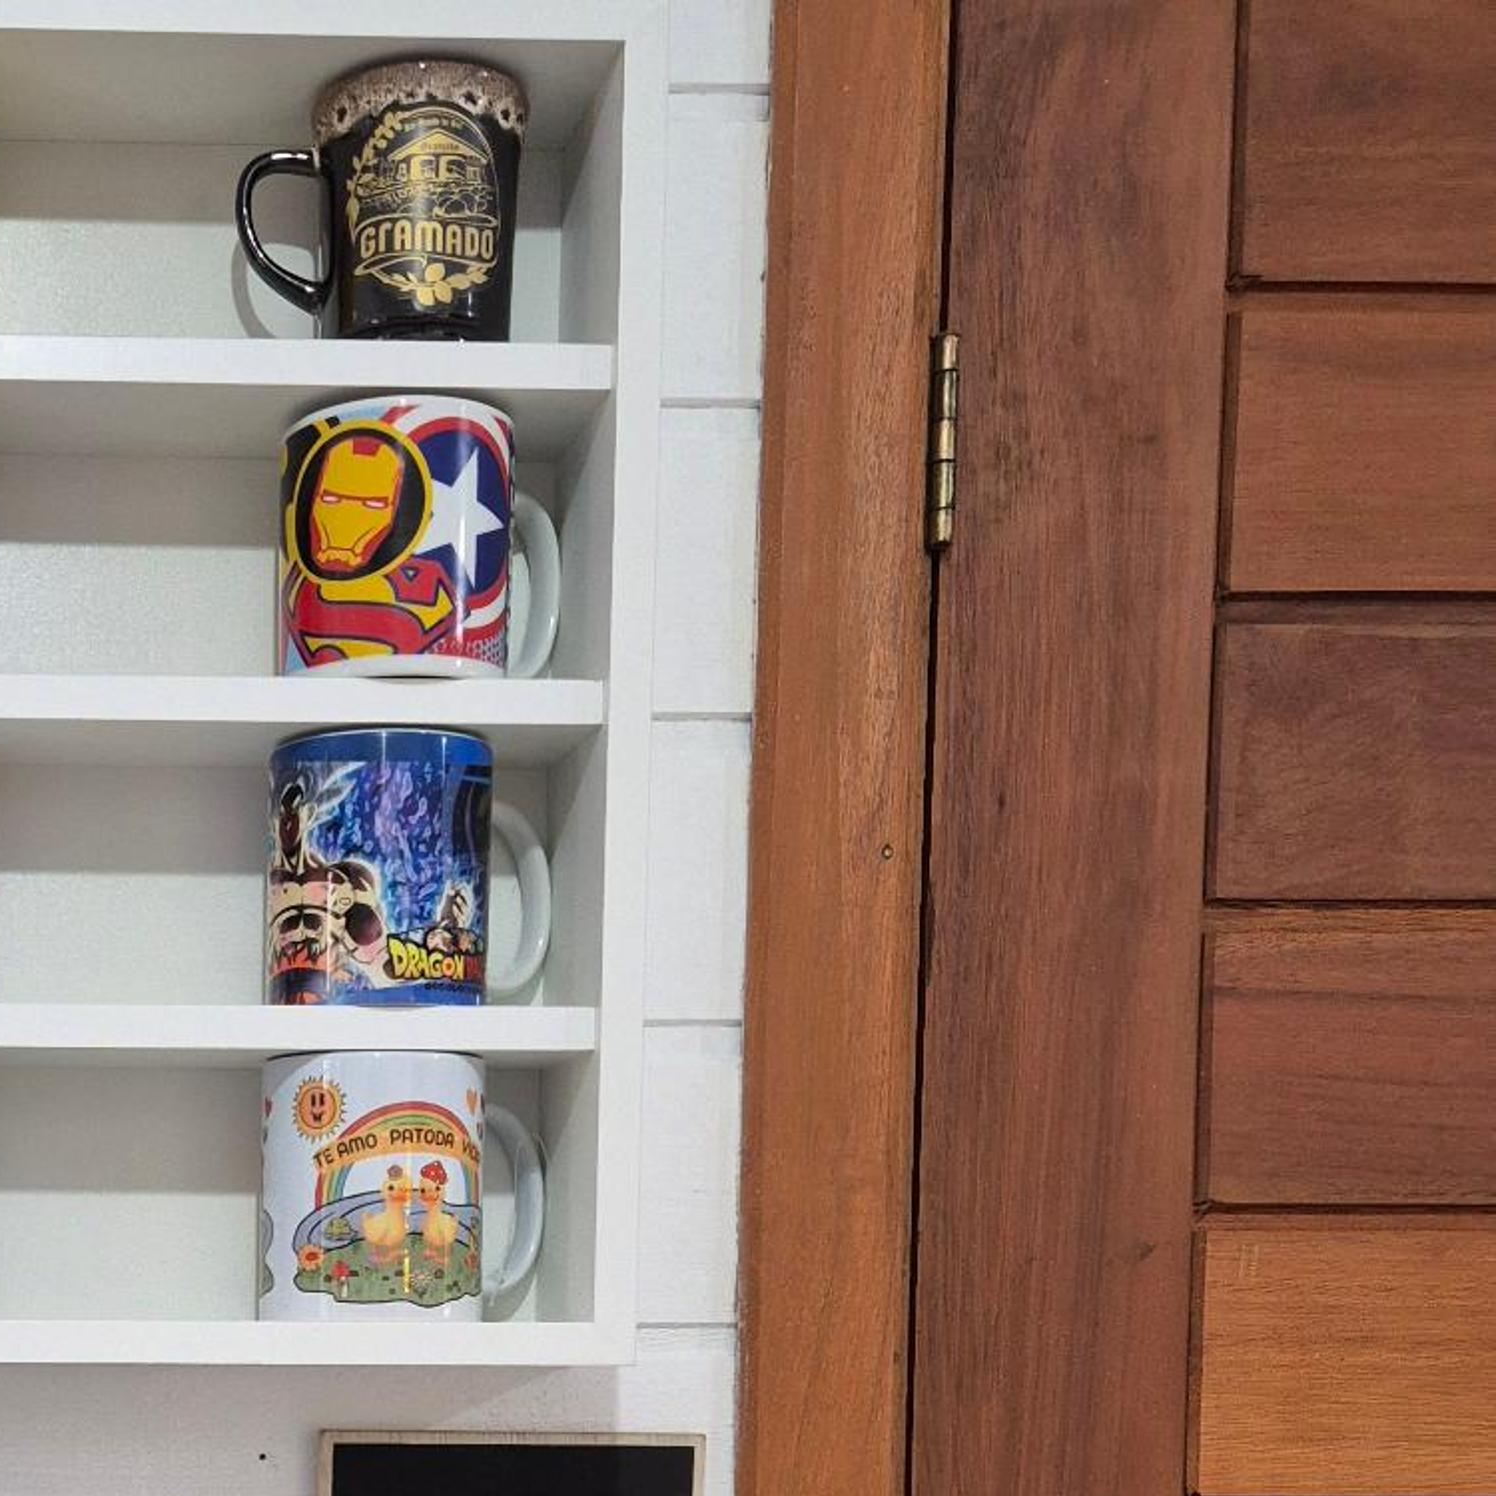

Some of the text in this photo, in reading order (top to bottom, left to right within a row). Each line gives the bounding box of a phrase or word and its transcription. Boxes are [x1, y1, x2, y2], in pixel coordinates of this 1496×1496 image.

[387, 936, 464, 980] DRAGON
[313, 1150, 335, 1168] TE
[336, 1133, 378, 1157] AMO
